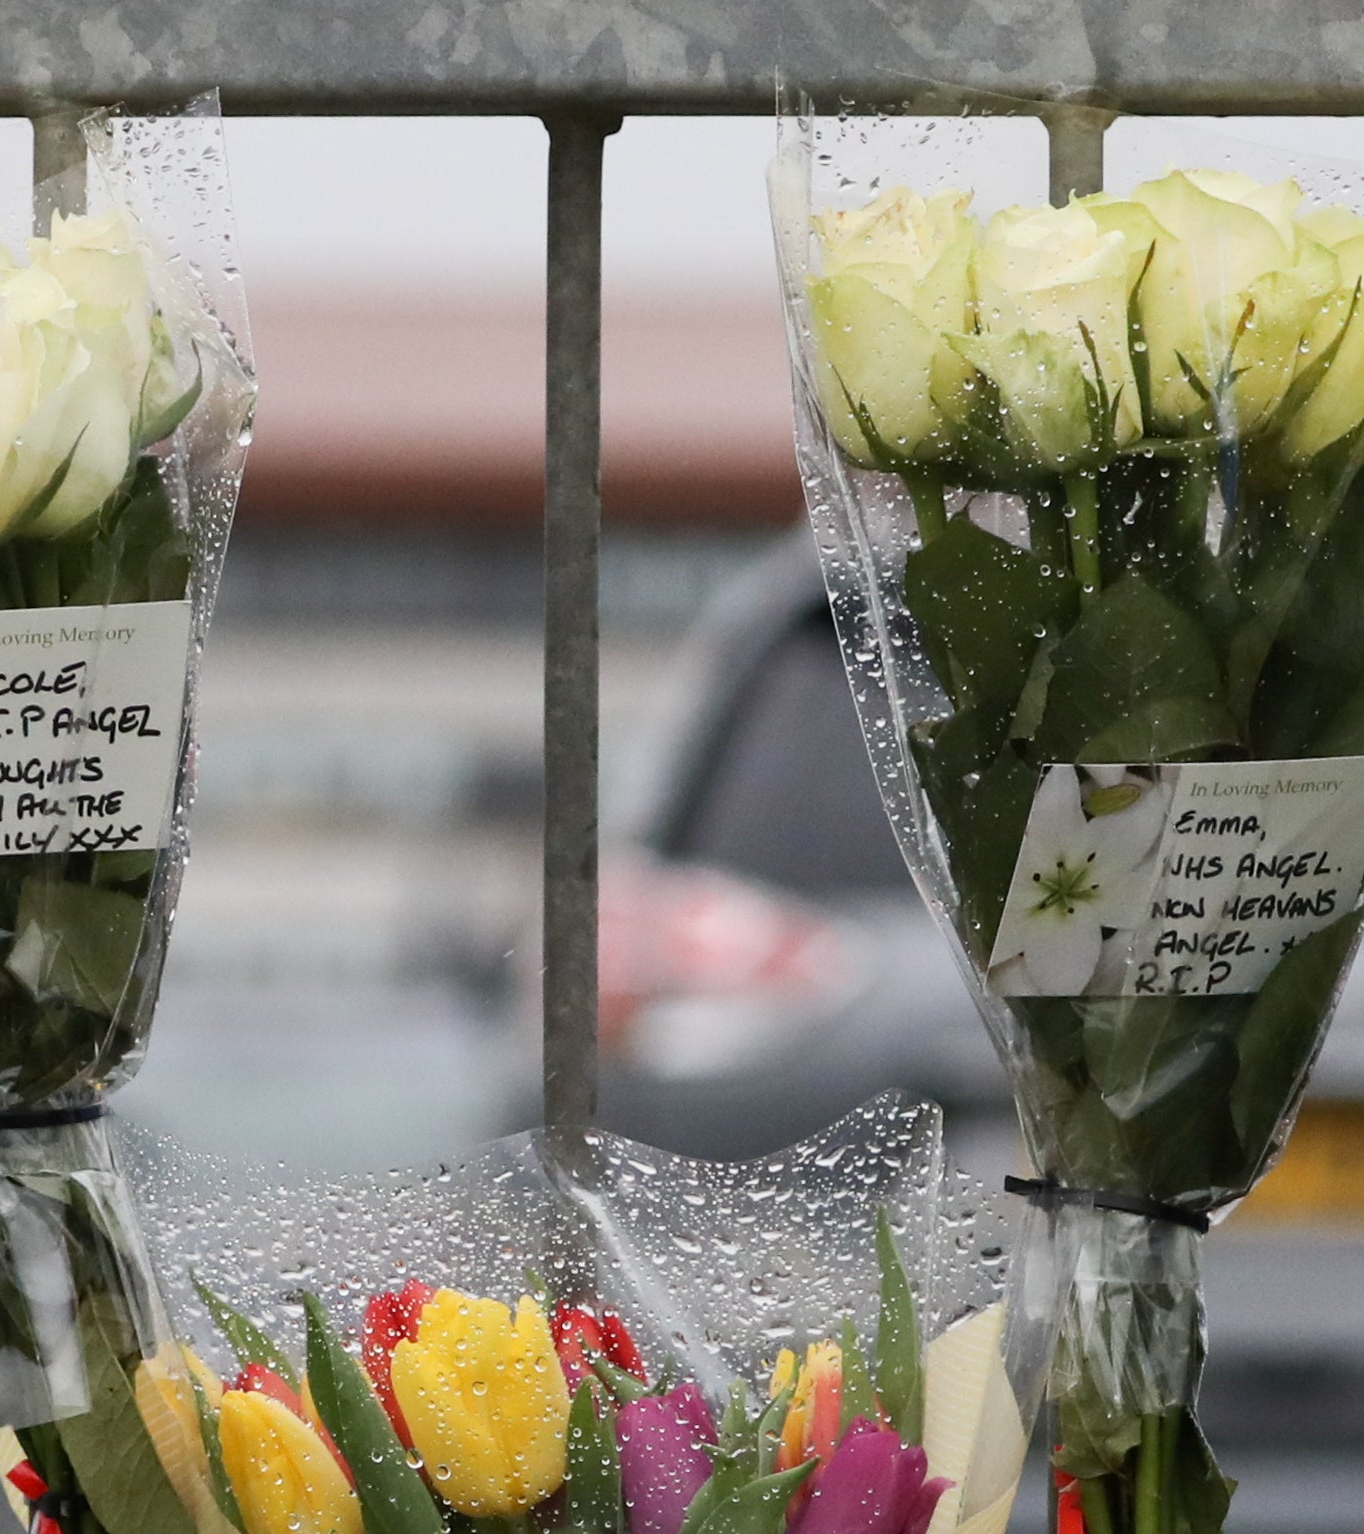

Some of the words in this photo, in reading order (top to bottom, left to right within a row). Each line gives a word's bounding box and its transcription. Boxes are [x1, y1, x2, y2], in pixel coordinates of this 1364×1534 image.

[59, 626, 137, 648] Memory
[52, 704, 162, 745] ANGEL
[1190, 781, 1209, 798] In
[1213, 780, 1270, 801] Loving
[1274, 777, 1344, 799] Memory
[69, 790, 125, 818] THE
[1162, 853, 1225, 879] NHS
[1236, 851, 1343, 889] ANGEL.
[1222, 889, 1337, 920] HEAVANS
